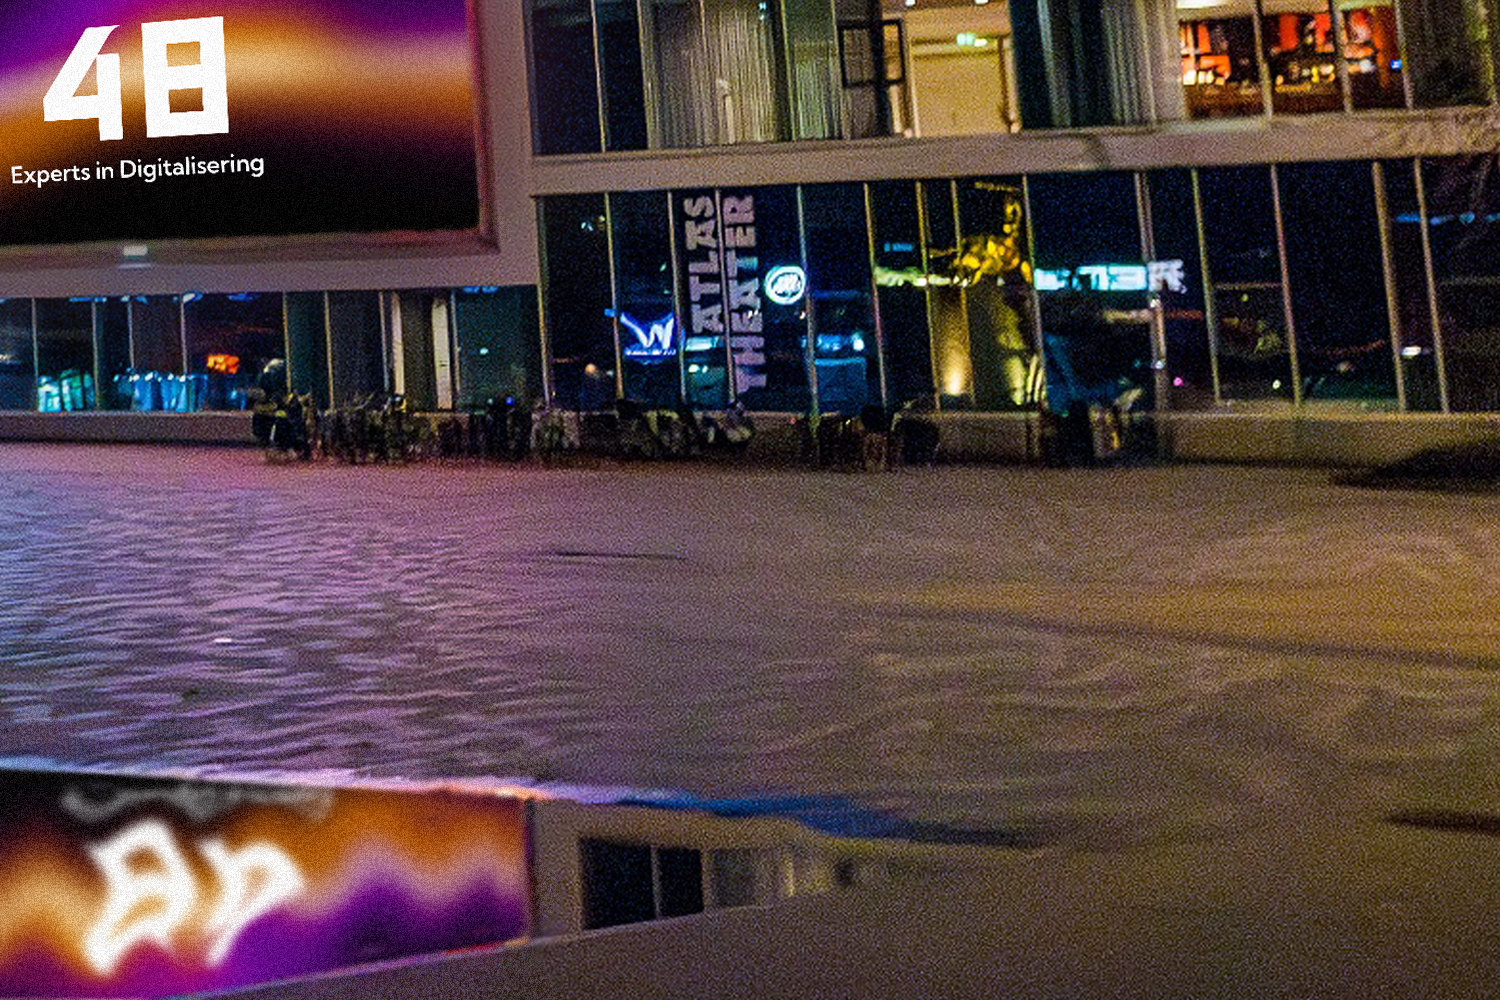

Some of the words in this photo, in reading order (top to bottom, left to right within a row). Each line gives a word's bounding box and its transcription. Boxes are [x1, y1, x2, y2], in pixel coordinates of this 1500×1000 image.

[11, 165, 90, 188] Experts
[96, 161, 114, 180] in
[120, 153, 265, 183] Digitalisering
[684, 195, 725, 333] ATLAS
[722, 195, 767, 394] THEATER
